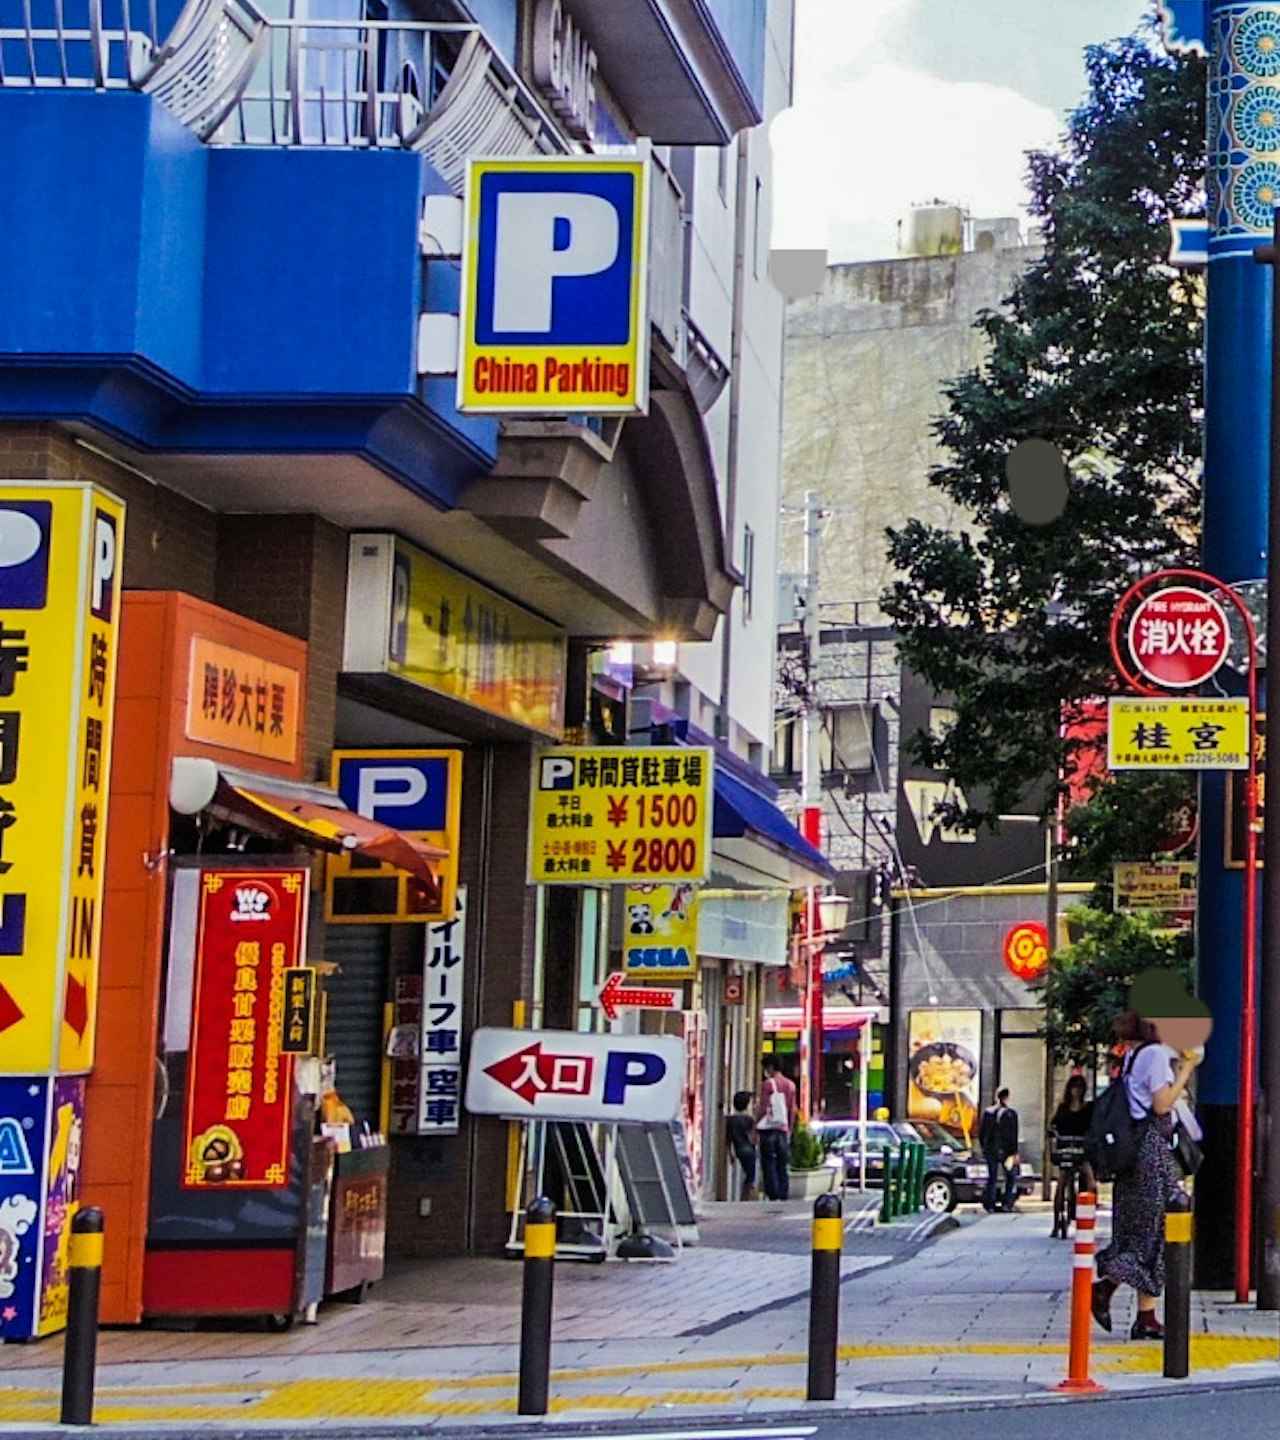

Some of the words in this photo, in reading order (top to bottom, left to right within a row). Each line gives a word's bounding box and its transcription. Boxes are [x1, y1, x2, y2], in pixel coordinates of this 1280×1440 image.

[493, 192, 619, 333] P
[474, 356, 537, 394] China
[544, 356, 630, 398] Parking
[91, 517, 116, 611] P
[1147, 601, 1168, 613] FIRE
[1170, 601, 1213, 613] HYDRANT
[1139, 618, 1221, 656] 消火栓
[1129, 721, 1227, 751] 桂宮
[579, 756, 702, 788] 時間貸駐車場
[357, 766, 428, 821] P
[558, 795, 581, 810] 平日
[547, 813, 593, 828] 最大料金
[544, 858, 591, 873] 最大料金
[71, 896, 94, 959] IN
[627, 947, 691, 969] SEGA
[424, 1068, 459, 1126] 空車
[511, 1055, 588, 1092] 入口
[602, 1051, 667, 1105] P
